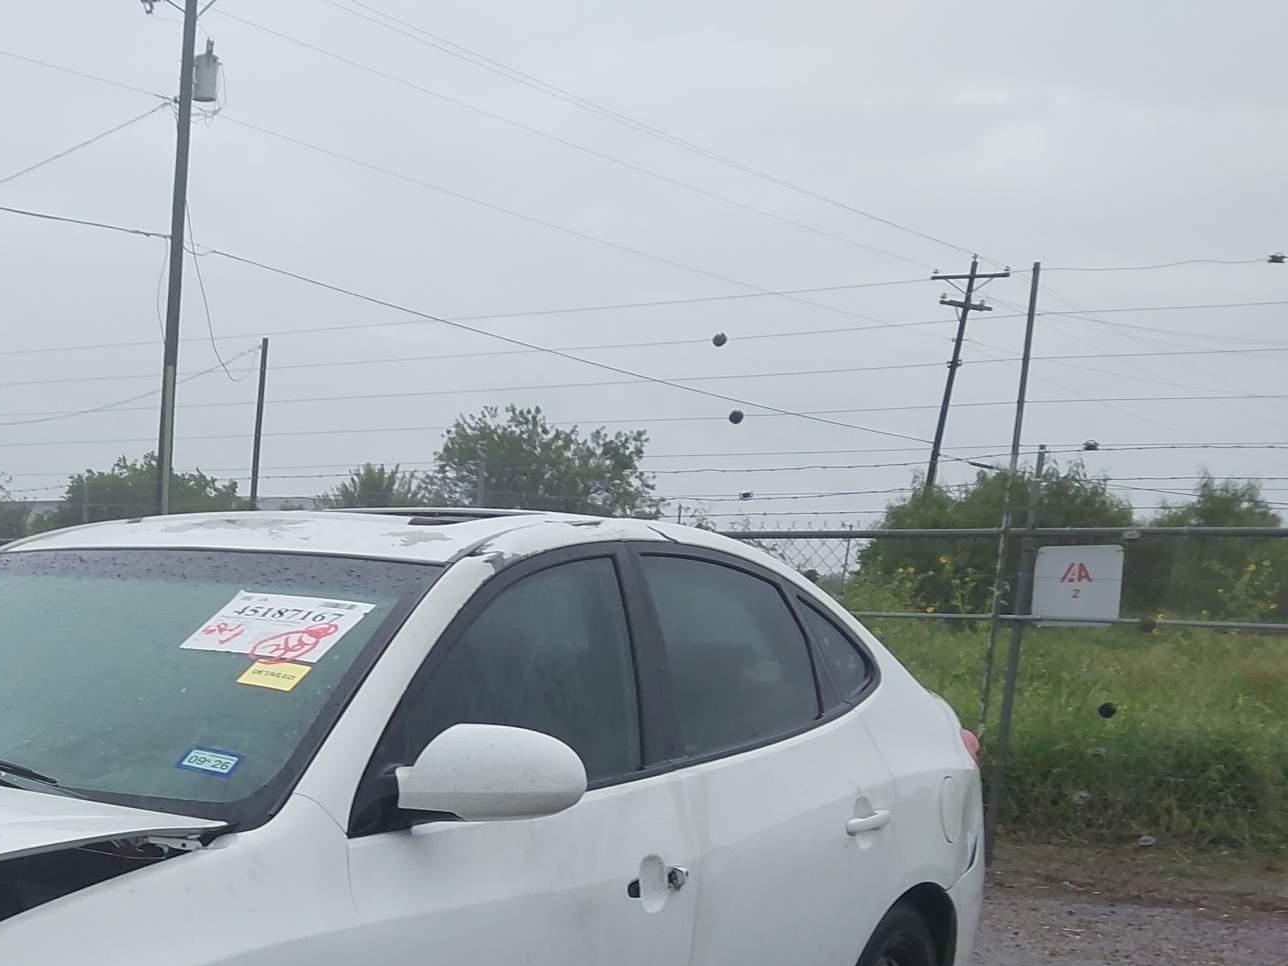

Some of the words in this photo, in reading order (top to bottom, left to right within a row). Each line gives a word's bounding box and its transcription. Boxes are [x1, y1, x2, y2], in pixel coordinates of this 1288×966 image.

[1071, 588, 1081, 599] 2
[233, 604, 344, 623] 45187167
[251, 669, 296, 680] DETAILED
